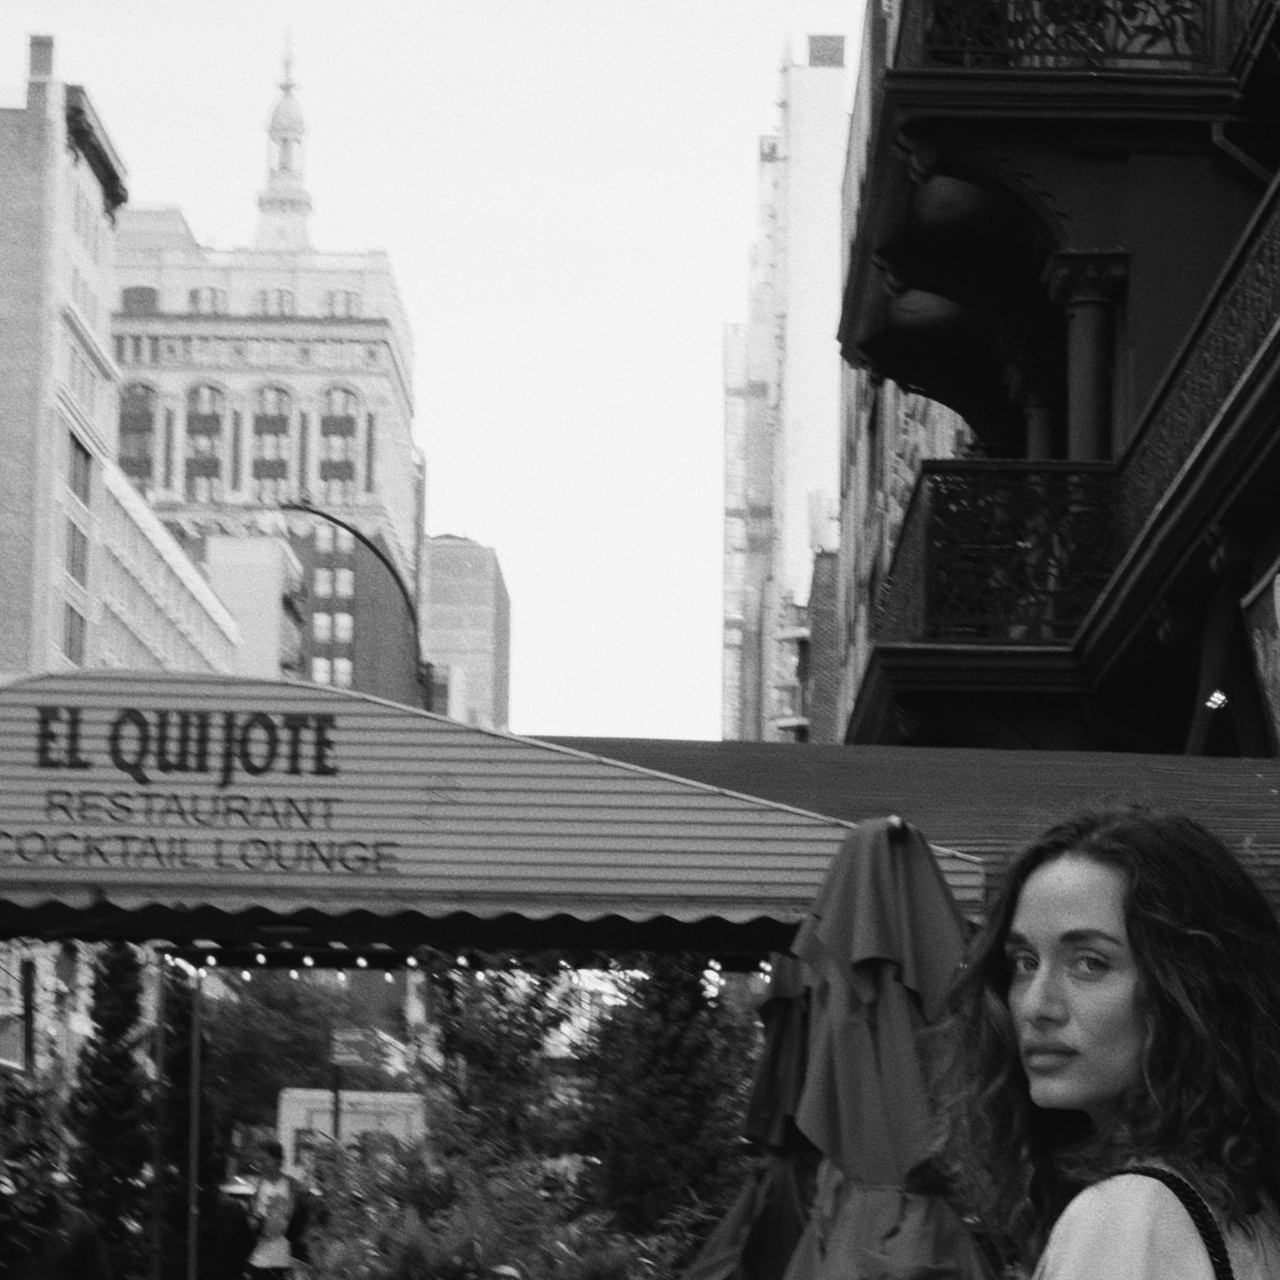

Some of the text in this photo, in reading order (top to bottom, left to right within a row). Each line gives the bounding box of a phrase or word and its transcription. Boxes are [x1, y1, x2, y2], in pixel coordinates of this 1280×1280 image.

[36, 705, 338, 788] EL QUIJOTE
[45, 790, 345, 831] RESTAURANT
[213, 837, 401, 875] LOUNGE
